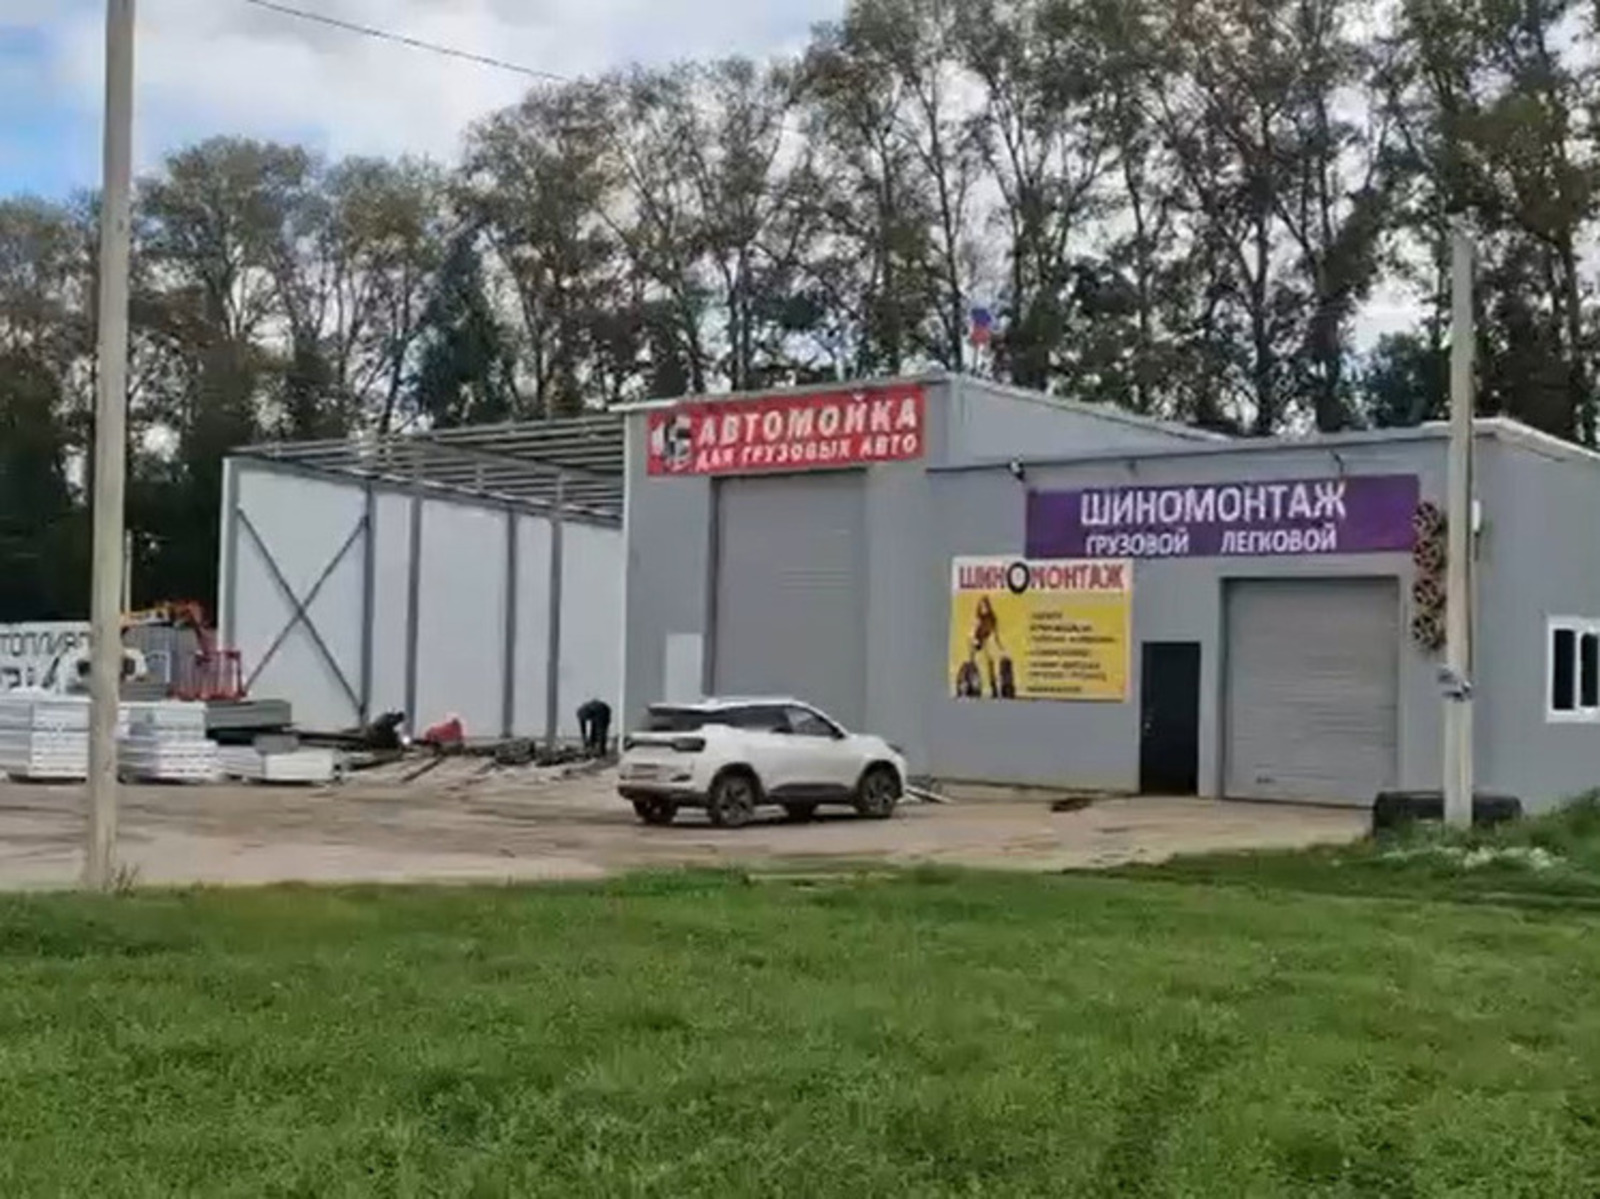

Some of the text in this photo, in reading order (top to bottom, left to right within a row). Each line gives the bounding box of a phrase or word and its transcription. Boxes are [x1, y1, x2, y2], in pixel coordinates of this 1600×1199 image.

[697, 393, 917, 447] АВТОМОЙКА
[695, 433, 917, 471] ДЛЯ ГРУЗОВЫХ АВТО
[1080, 481, 1347, 526] ШИНОМОНТАЖ
[1085, 524, 1337, 556] ГРУЗОВОЙ ЛЕГКОВОЙ
[959, 562, 1124, 594] ШИНОМОНТАЖ
